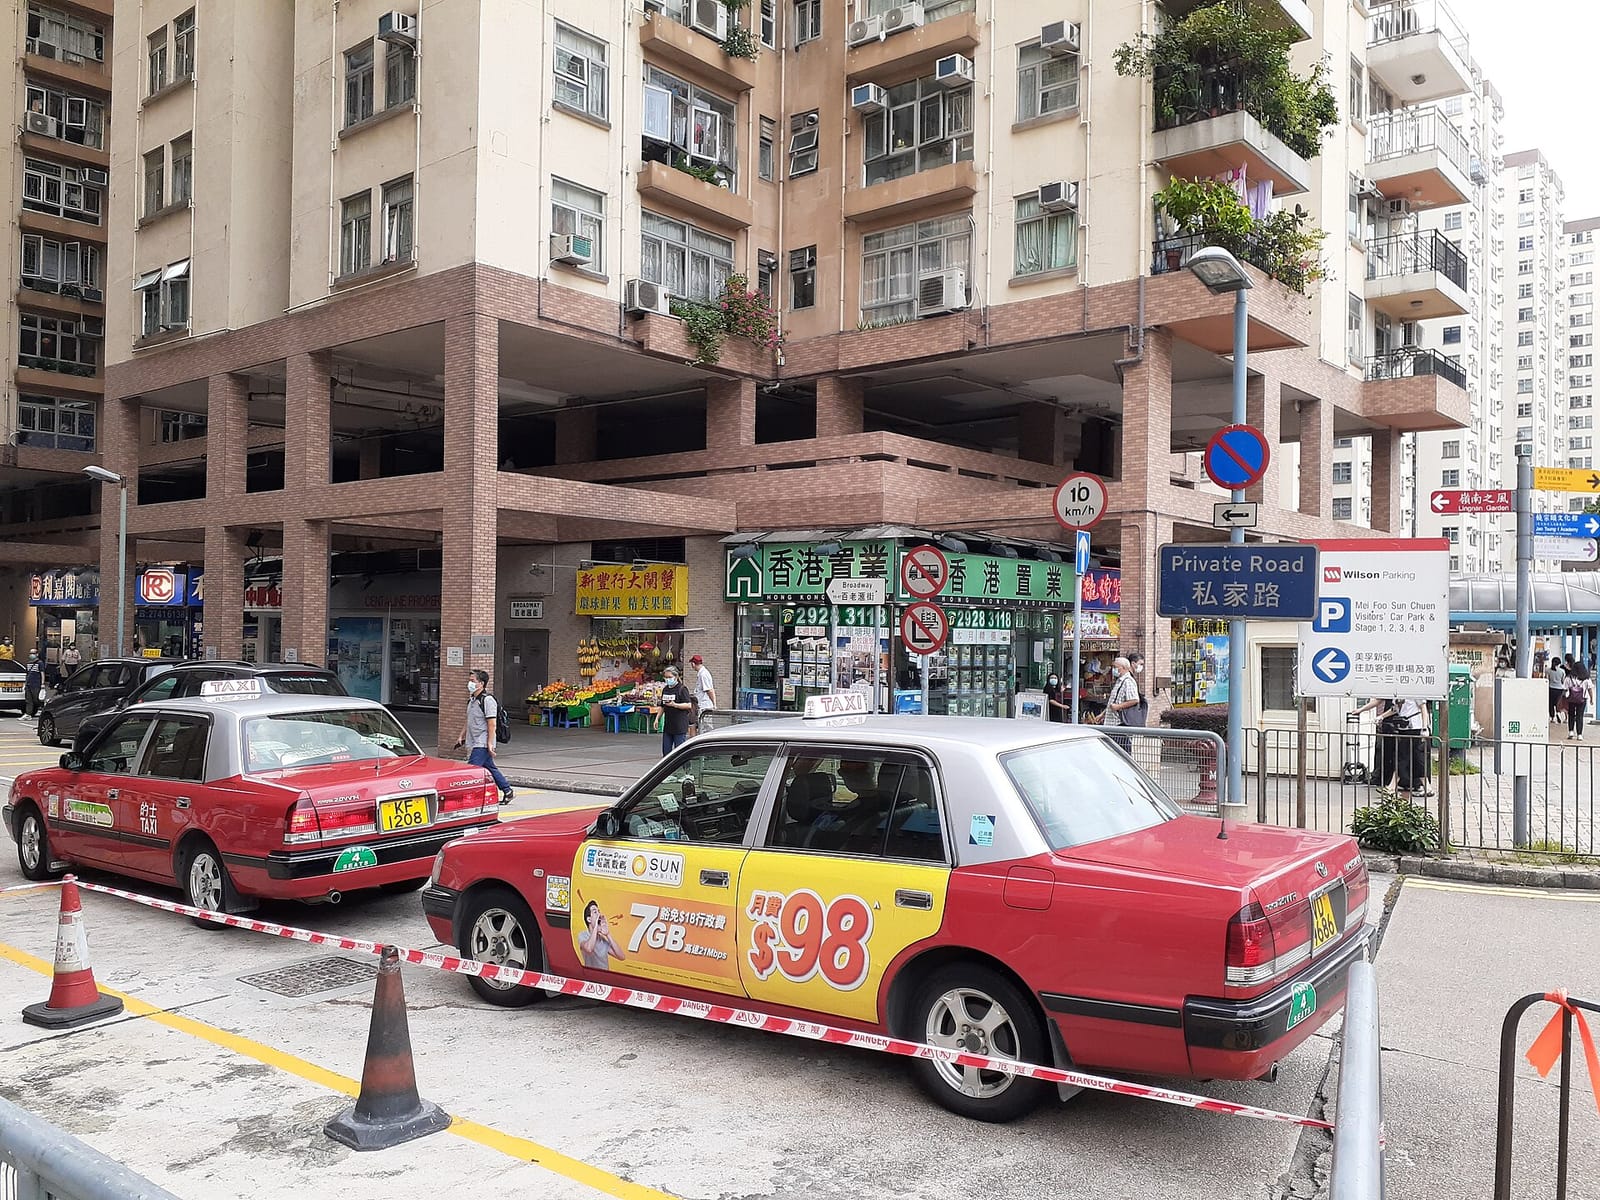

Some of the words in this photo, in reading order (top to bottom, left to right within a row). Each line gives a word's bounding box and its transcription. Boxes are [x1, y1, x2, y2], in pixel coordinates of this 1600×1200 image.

[1070, 486, 1090, 502] 10
[1459, 492, 1509, 504] 嶺南之風
[1065, 505, 1095, 517] km/h
[1171, 555, 1242, 573] Private
[1250, 555, 1304, 573] Road
[949, 558, 1062, 599] 香港置業
[1343, 570, 1380, 579] Wilson
[1382, 571, 1416, 581] Parking
[842, 581, 873, 589] Broadway
[1191, 581, 1281, 608] 私家路
[1355, 601, 1370, 610] Mei
[1373, 601, 1388, 610] Foo
[1391, 601, 1407, 610] Sun
[1410, 601, 1436, 610] Chuen
[957, 610, 985, 627] 2928
[988, 611, 1012, 628] 3118
[1320, 601, 1345, 628] P
[1390, 613, 1404, 621] Car
[1407, 612, 1425, 621] Park
[1428, 613, 1435, 621] &
[1355, 623, 1377, 633] Stage
[1419, 624, 1425, 632] 8
[1355, 652, 1393, 661] 美孚新邨
[1355, 663, 1436, 674] 往訪客停車場及第
[211, 680, 256, 693] TAXI
[820, 695, 863, 713] TAXI
[140, 802, 157, 818] 的士
[394, 800, 414, 815] KF
[140, 817, 158, 834] TAXI
[388, 812, 423, 829] 1208
[351, 852, 360, 862] 4
[343, 860, 369, 869] SEATS
[649, 858, 680, 874] SUN
[649, 872, 678, 881] MOBILE
[750, 894, 782, 918] 月費
[750, 892, 869, 985] $98
[424, 952, 444, 962] DANGER
[541, 974, 565, 985] DANGER
[682, 1001, 711, 1012] DANGER
[1301, 993, 1307, 1008] 4
[1293, 1006, 1311, 1023] SEATS
[854, 1033, 888, 1047] DANGER
